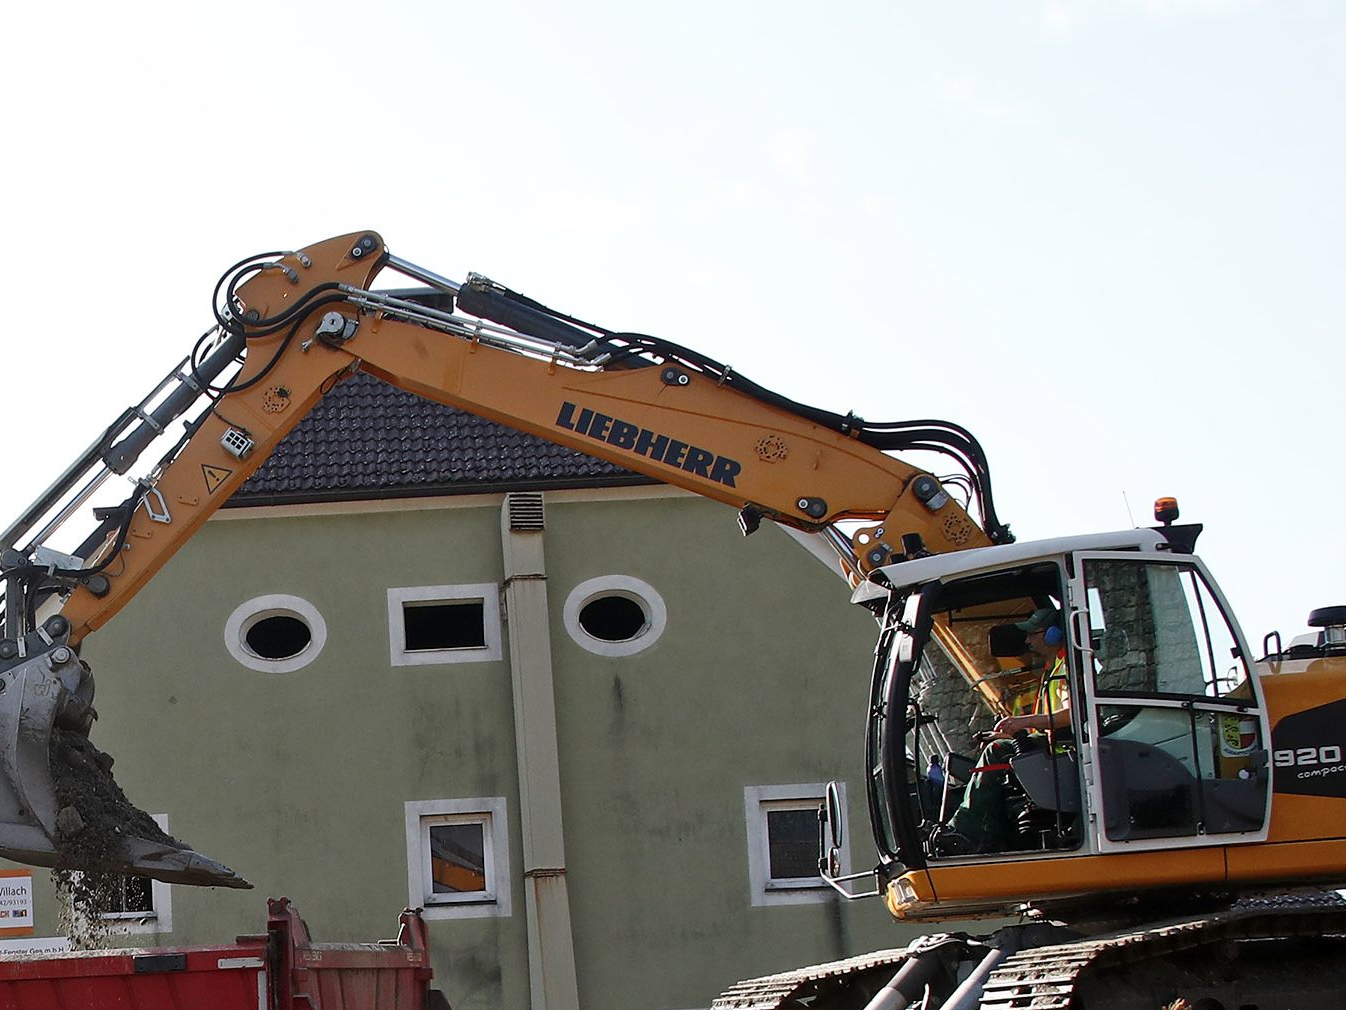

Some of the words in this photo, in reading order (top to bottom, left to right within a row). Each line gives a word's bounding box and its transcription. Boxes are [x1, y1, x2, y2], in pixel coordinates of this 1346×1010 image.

[556, 401, 741, 488] LIEBHERR
[1274, 745, 1341, 767] 920
[1297, 765, 1346, 779] compac
